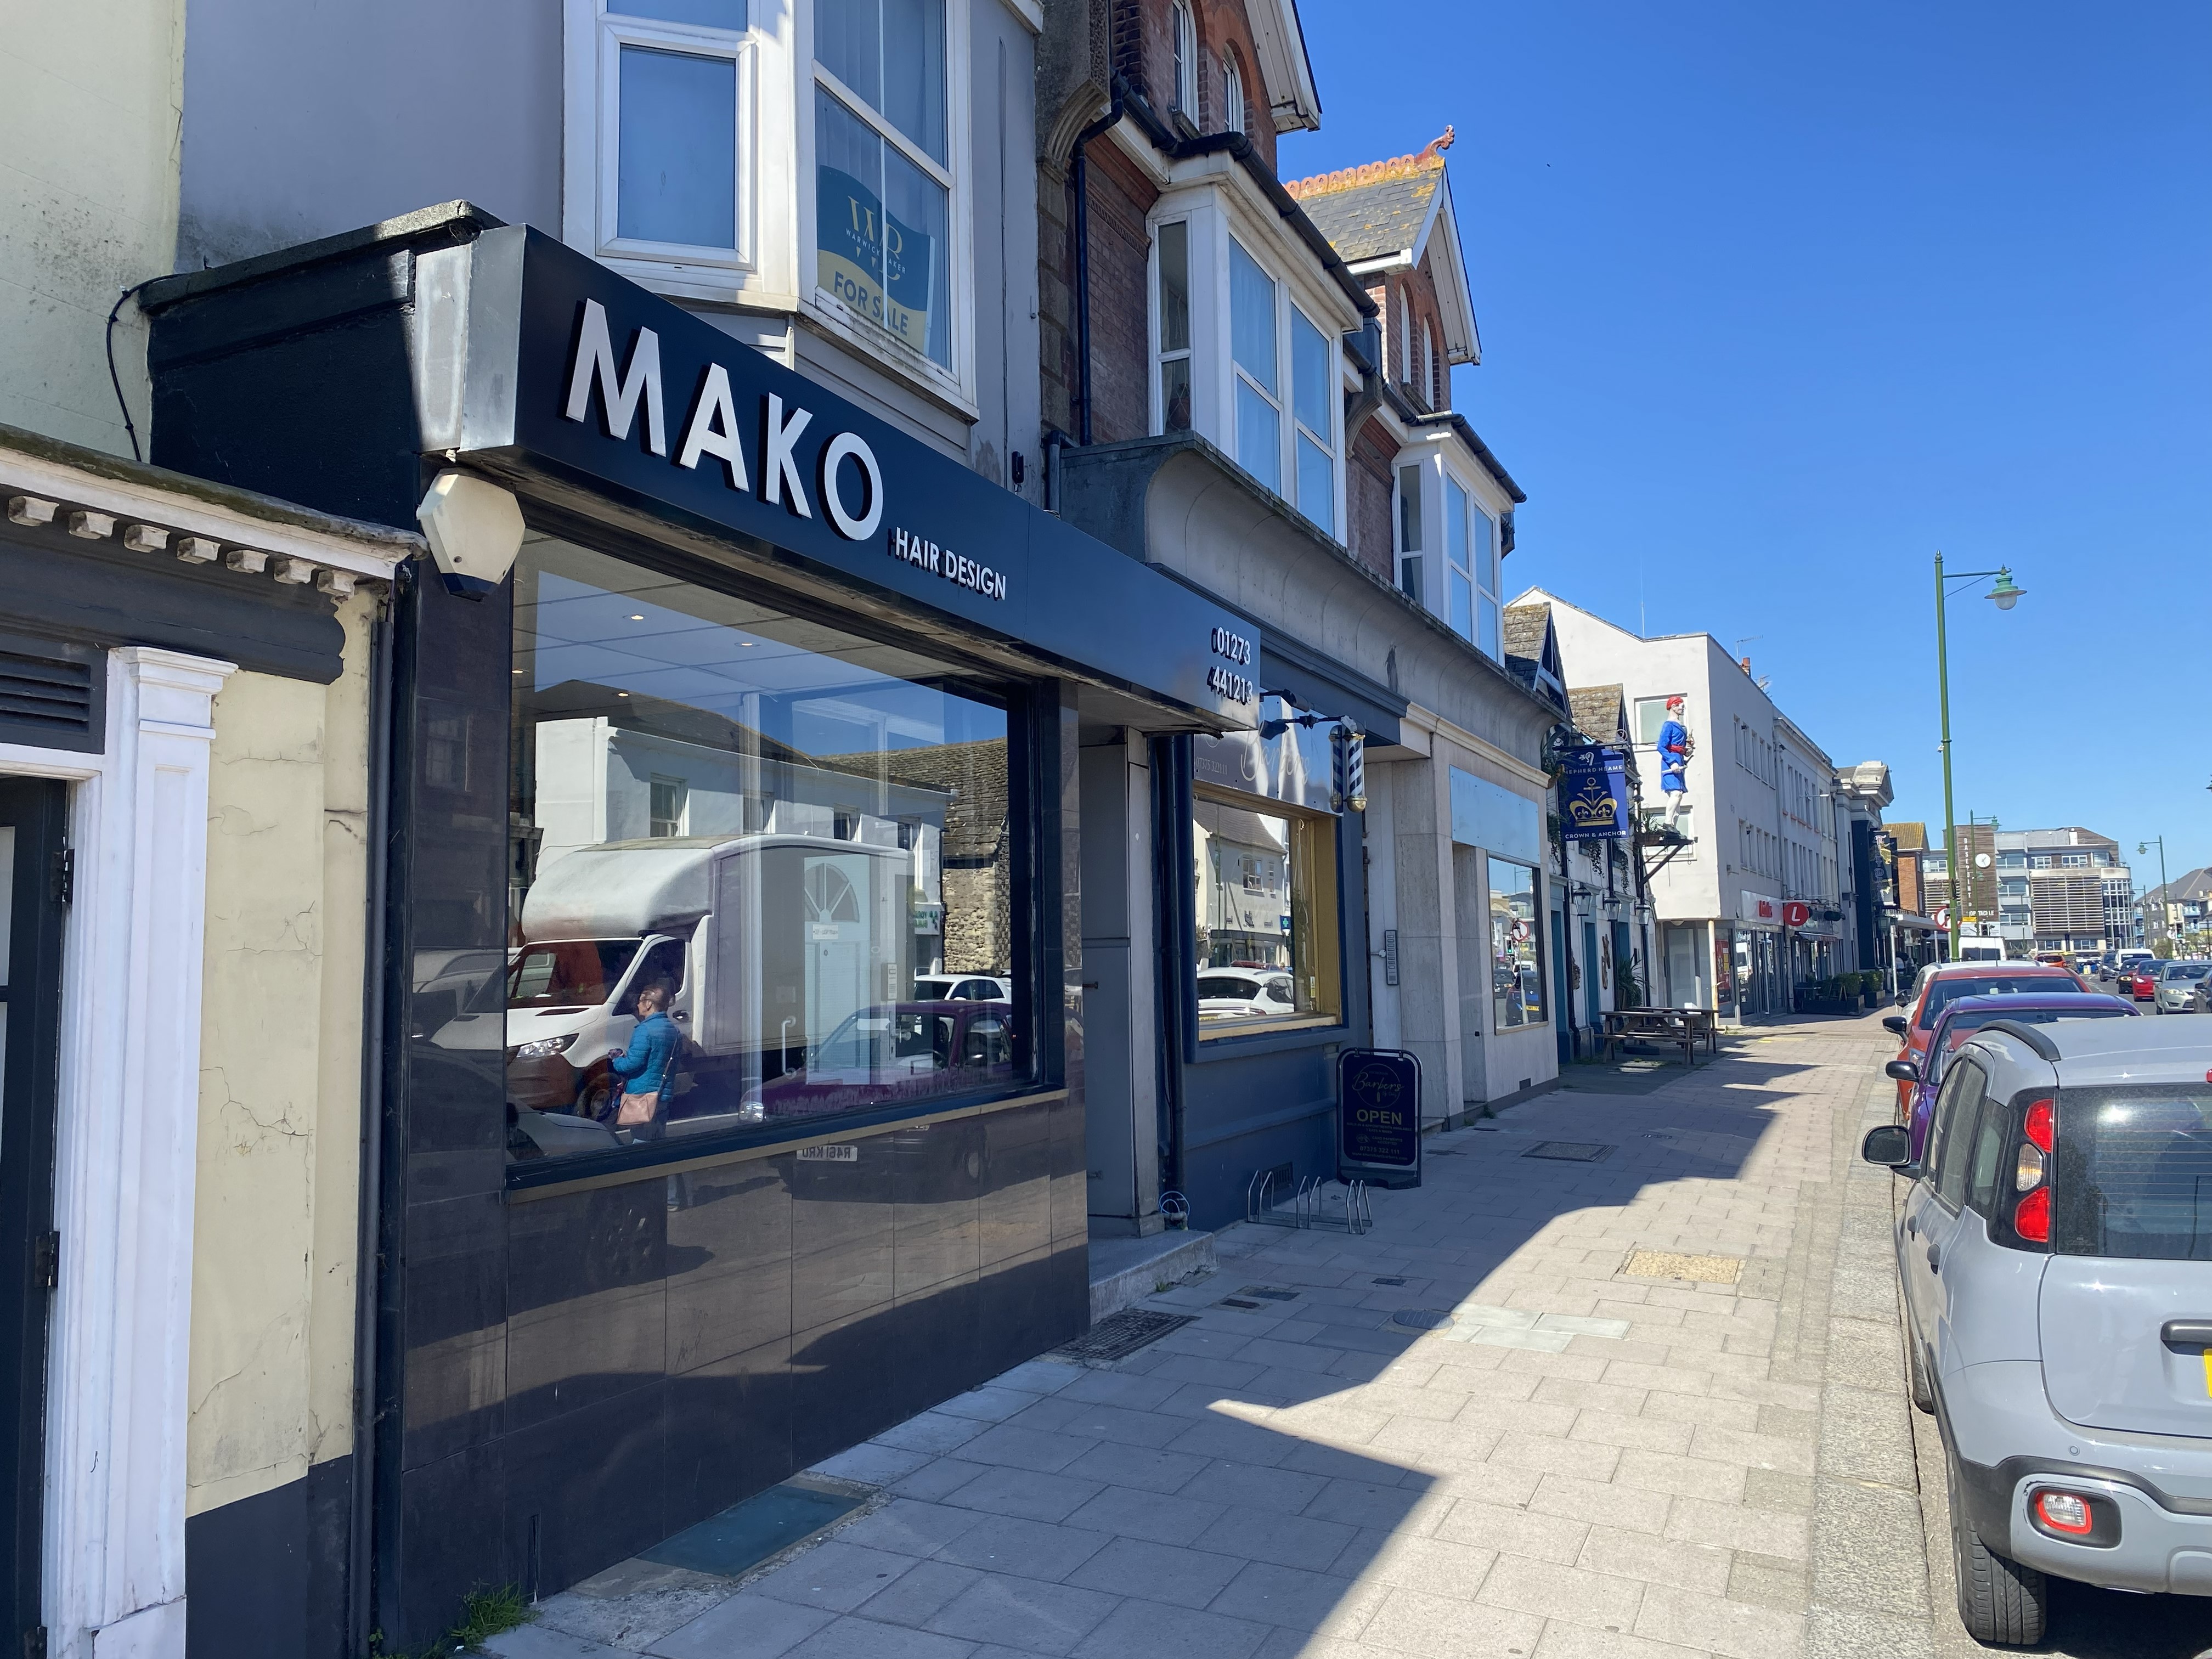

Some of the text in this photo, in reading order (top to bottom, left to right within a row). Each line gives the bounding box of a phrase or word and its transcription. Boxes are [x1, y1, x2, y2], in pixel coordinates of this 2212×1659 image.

[846, 228, 906, 274] WARWICK AKER
[834, 271, 868, 311] FOR
[567, 298, 884, 541] MAKO
[895, 527, 1007, 601] HAIR DESIGN
[1217, 627, 1251, 665] 01273
[1212, 665, 1254, 706] 441213
[1791, 906, 1801, 922] L
[1352, 1071, 1404, 1092] Barbers
[1356, 1109, 1402, 1126] OPEN
